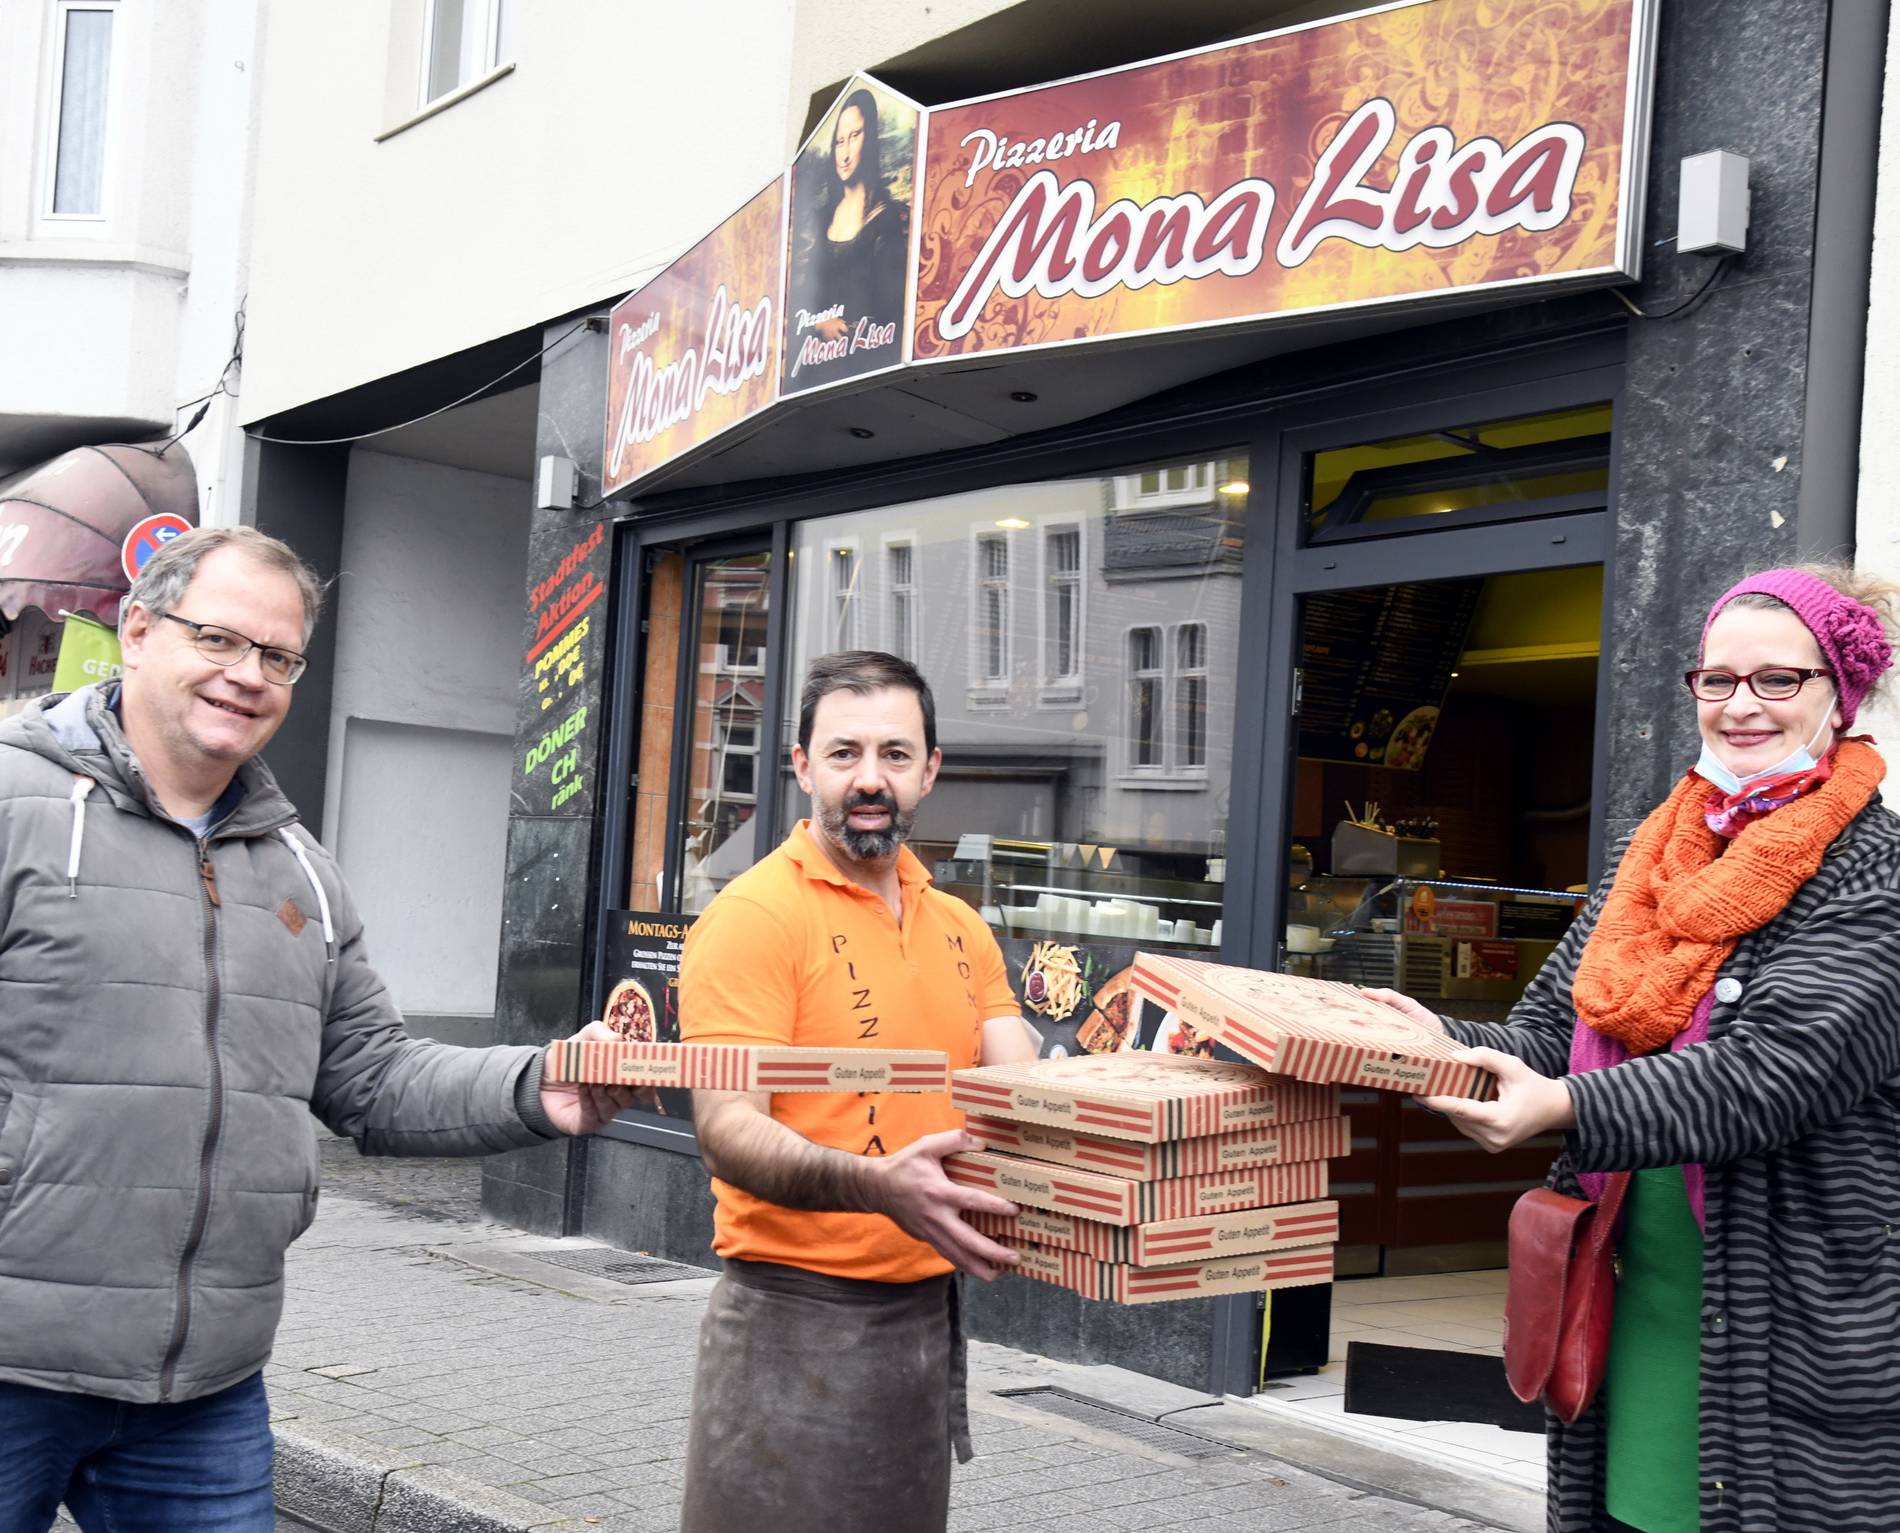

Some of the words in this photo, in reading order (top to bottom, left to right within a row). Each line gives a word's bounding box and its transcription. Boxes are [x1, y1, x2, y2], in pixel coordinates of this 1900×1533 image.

[961, 117, 1121, 188] Pizzeria
[938, 169, 1276, 341] Mona
[1277, 97, 1585, 268] Lisa
[795, 303, 845, 335] Pizzeria
[618, 310, 661, 364] Pizzeria
[791, 334, 848, 378] Mona
[850, 316, 896, 355] Lisa
[609, 350, 696, 479] Mona
[695, 283, 772, 412] Lisa
[536, 570, 593, 640] Aktion
[535, 616, 590, 679] POMMES
[525, 706, 588, 775] DÖNER
[628, 920, 690, 939] MONTAGS-A
[859, 1068, 886, 1081] Appetit
[1363, 1063, 1390, 1075] Guten
[1393, 1068, 1426, 1080] Appetit
[1017, 1094, 1040, 1107] Guten
[1043, 1099, 1072, 1114] Appetit
[1223, 1110, 1245, 1119] Guten
[1248, 1104, 1275, 1115] Appetit
[1222, 1149, 1246, 1158] Guten
[1249, 1144, 1277, 1155] Appetit
[1023, 1178, 1050, 1194] Appetit
[1200, 1190, 1223, 1200] Guten
[1226, 1186, 1255, 1197] Appetit
[1218, 1229, 1241, 1241] Guten
[1243, 1224, 1270, 1239] Appetit
[1205, 1269, 1229, 1281] Guten
[1231, 1265, 1261, 1279] Appetit
